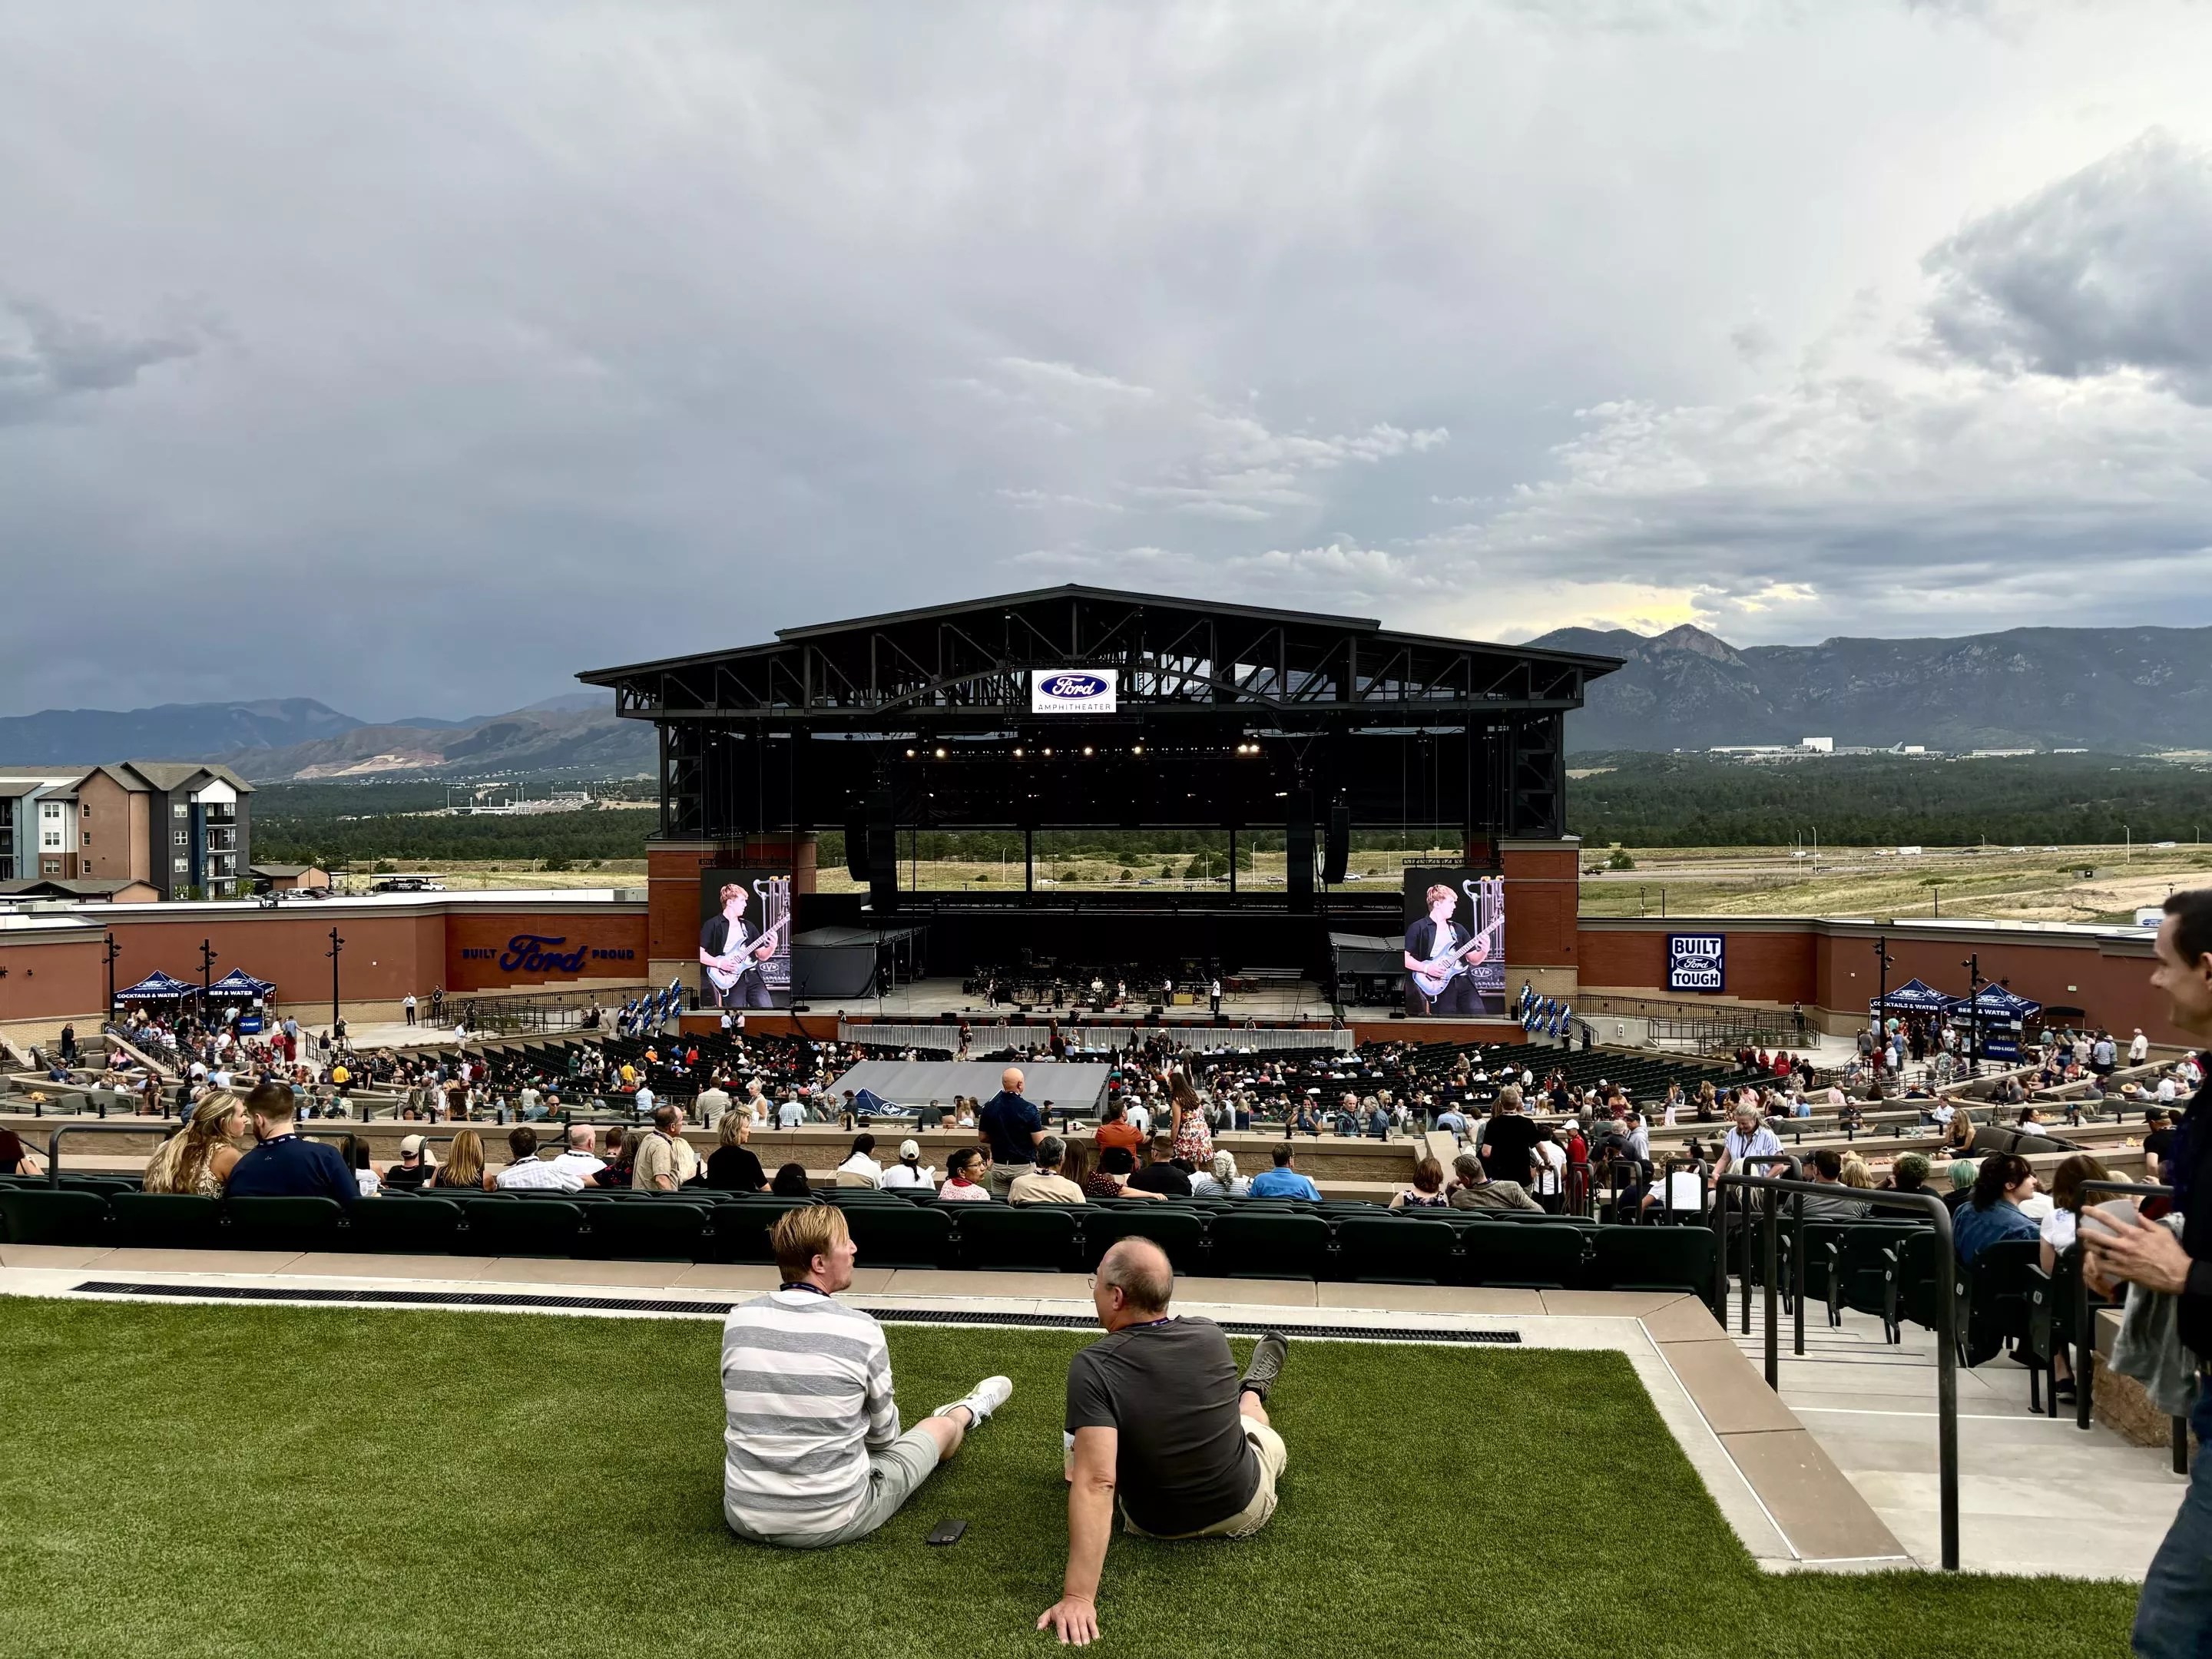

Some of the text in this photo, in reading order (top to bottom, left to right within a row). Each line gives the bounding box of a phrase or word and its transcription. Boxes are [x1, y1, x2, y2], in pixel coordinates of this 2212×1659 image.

[1051, 676, 1096, 695] Ford
[462, 934, 634, 972] BUILT Ford PROUD
[1674, 939, 1719, 954] BUILT
[1684, 958, 1709, 969] Ford
[1674, 973, 1719, 985] TOUGH
